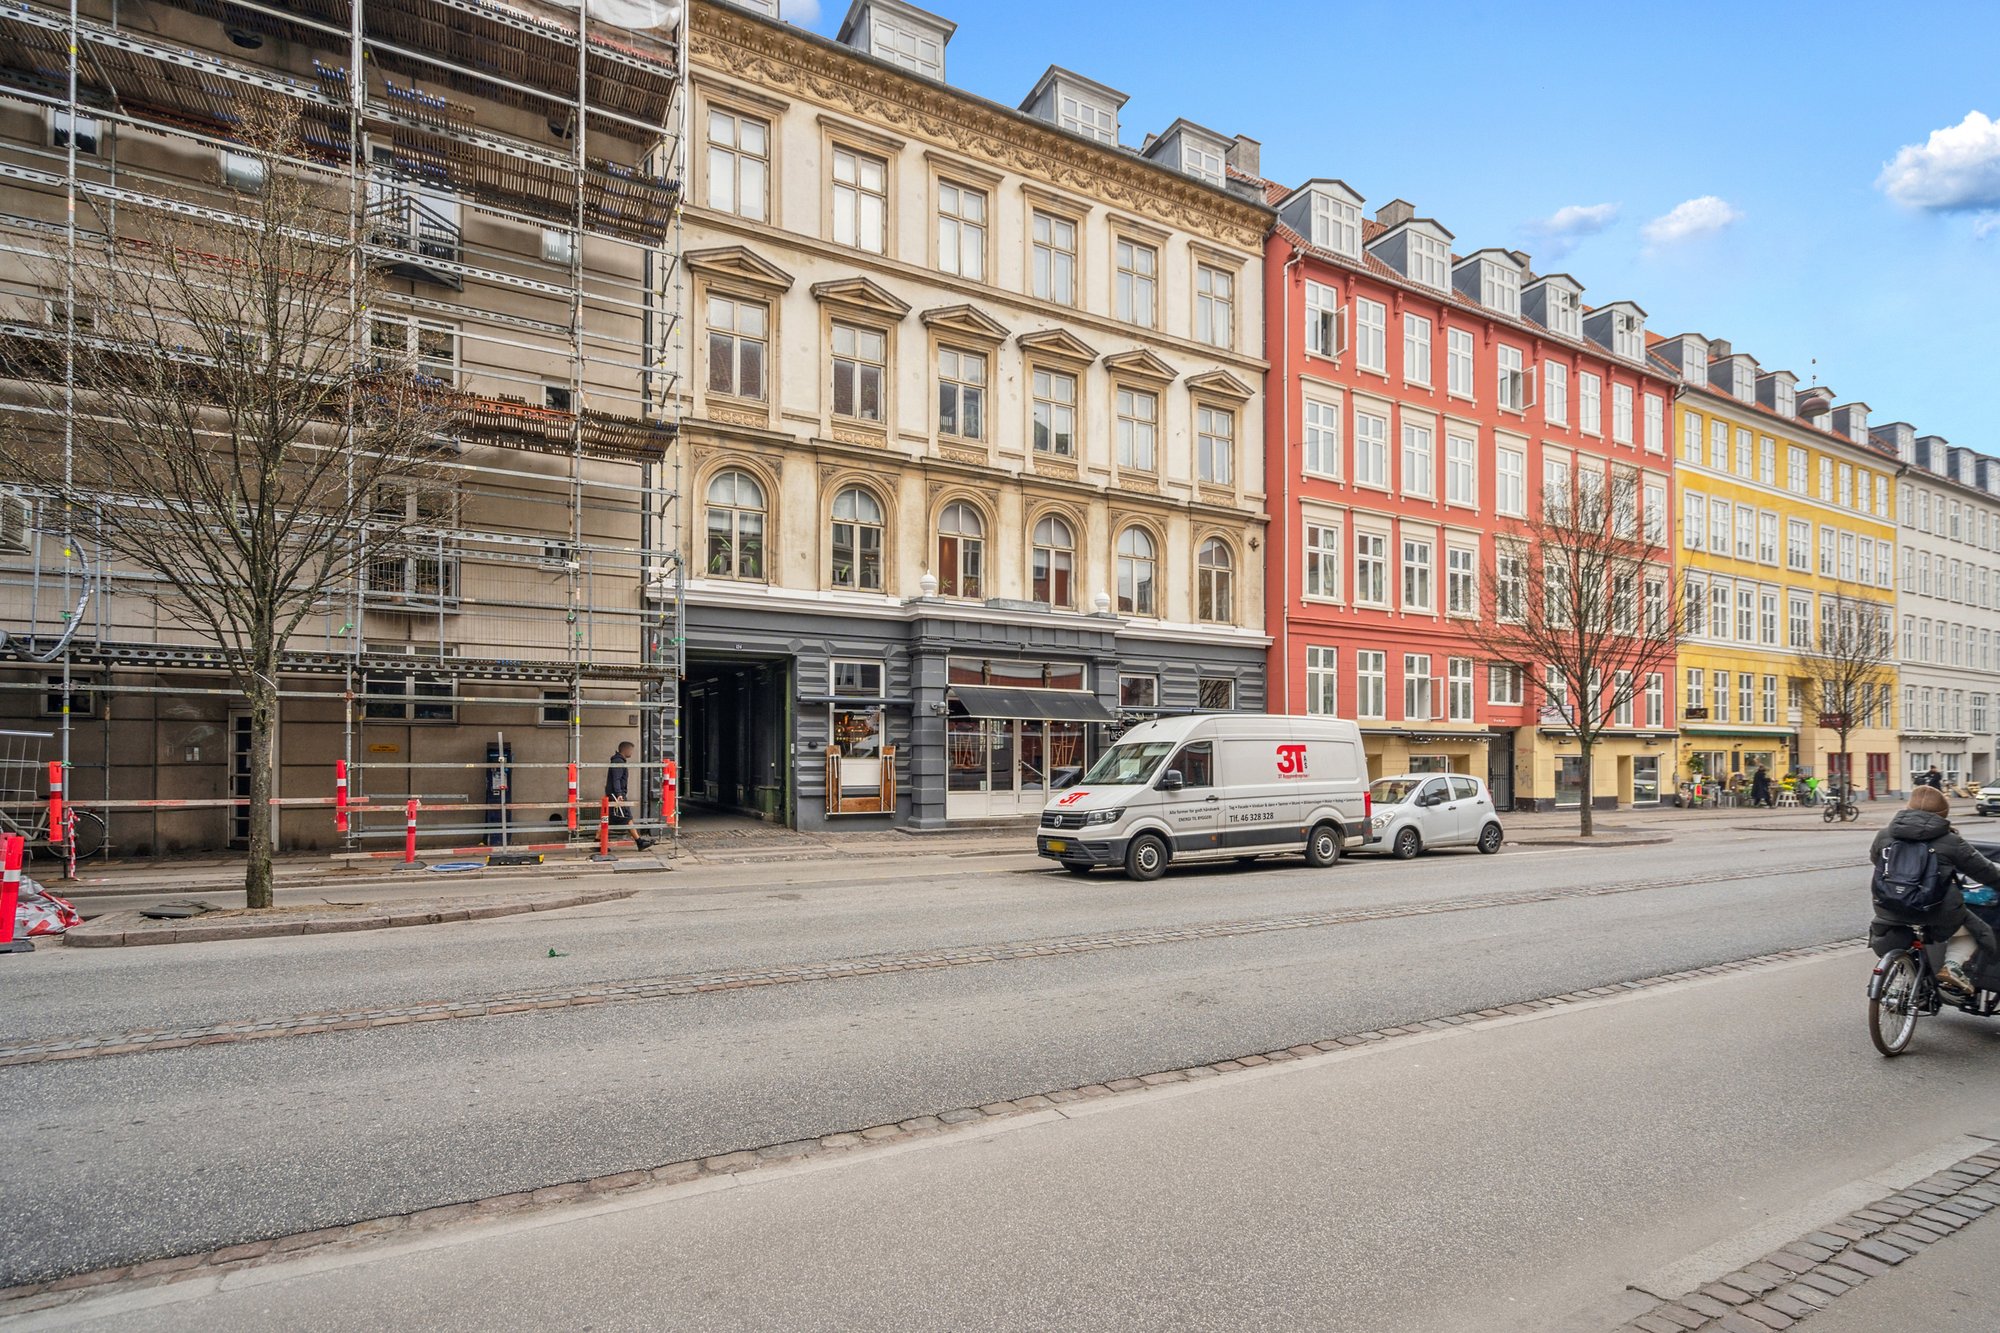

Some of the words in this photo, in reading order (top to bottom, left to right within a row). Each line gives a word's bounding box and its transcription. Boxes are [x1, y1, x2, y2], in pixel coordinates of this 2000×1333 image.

[1276, 744, 1307, 773] 3T
[1060, 792, 1090, 804] 3T
[1229, 814, 1240, 823] Tlf.
[1240, 813, 1249, 822] 46
[1250, 812, 1262, 821] 328
[1263, 811, 1274, 820] 328
